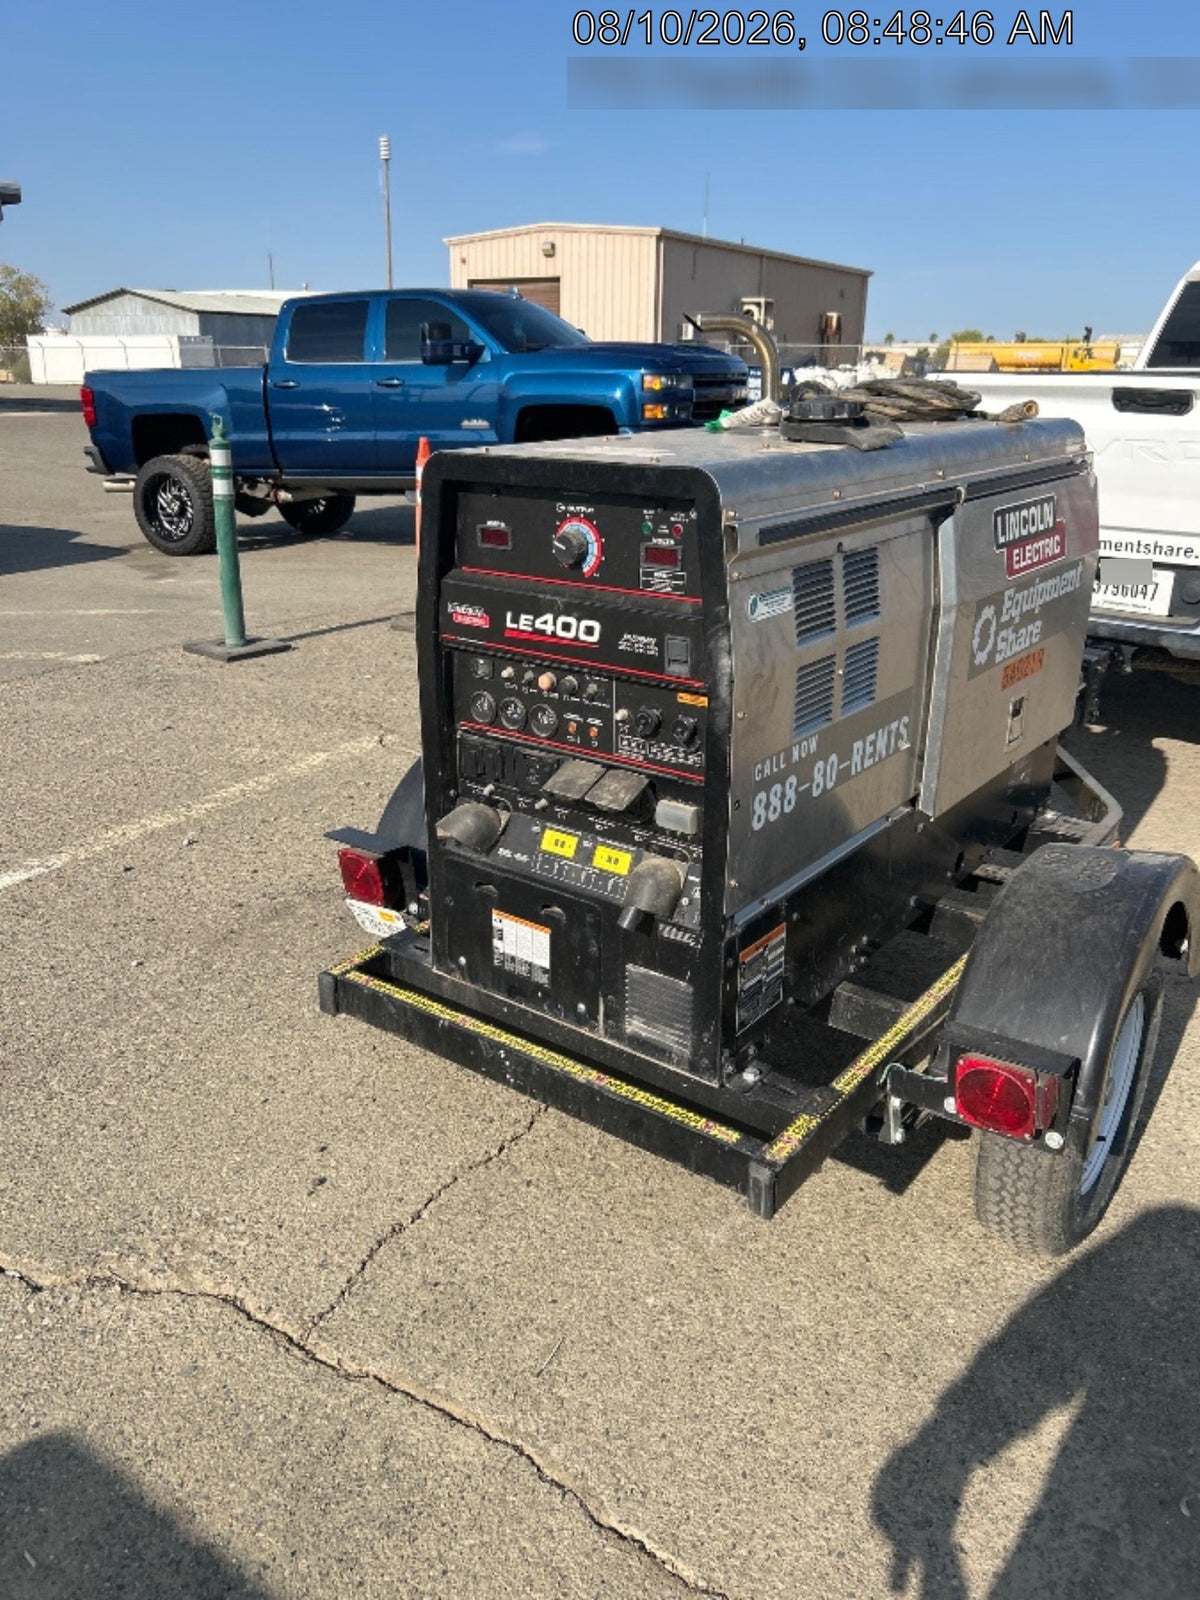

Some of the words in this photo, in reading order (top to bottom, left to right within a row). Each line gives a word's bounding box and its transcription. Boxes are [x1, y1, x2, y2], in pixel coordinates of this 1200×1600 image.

[997, 501, 1054, 544] LINCOLN
[1012, 534, 1061, 570] ELECTRIC
[1000, 561, 1084, 624] Equipment
[505, 611, 601, 643] LE400
[995, 620, 1042, 664] Share
[751, 715, 911, 831] 888-80-RENTS
[754, 753, 786, 782] CALL
[792, 734, 819, 763] NOW
